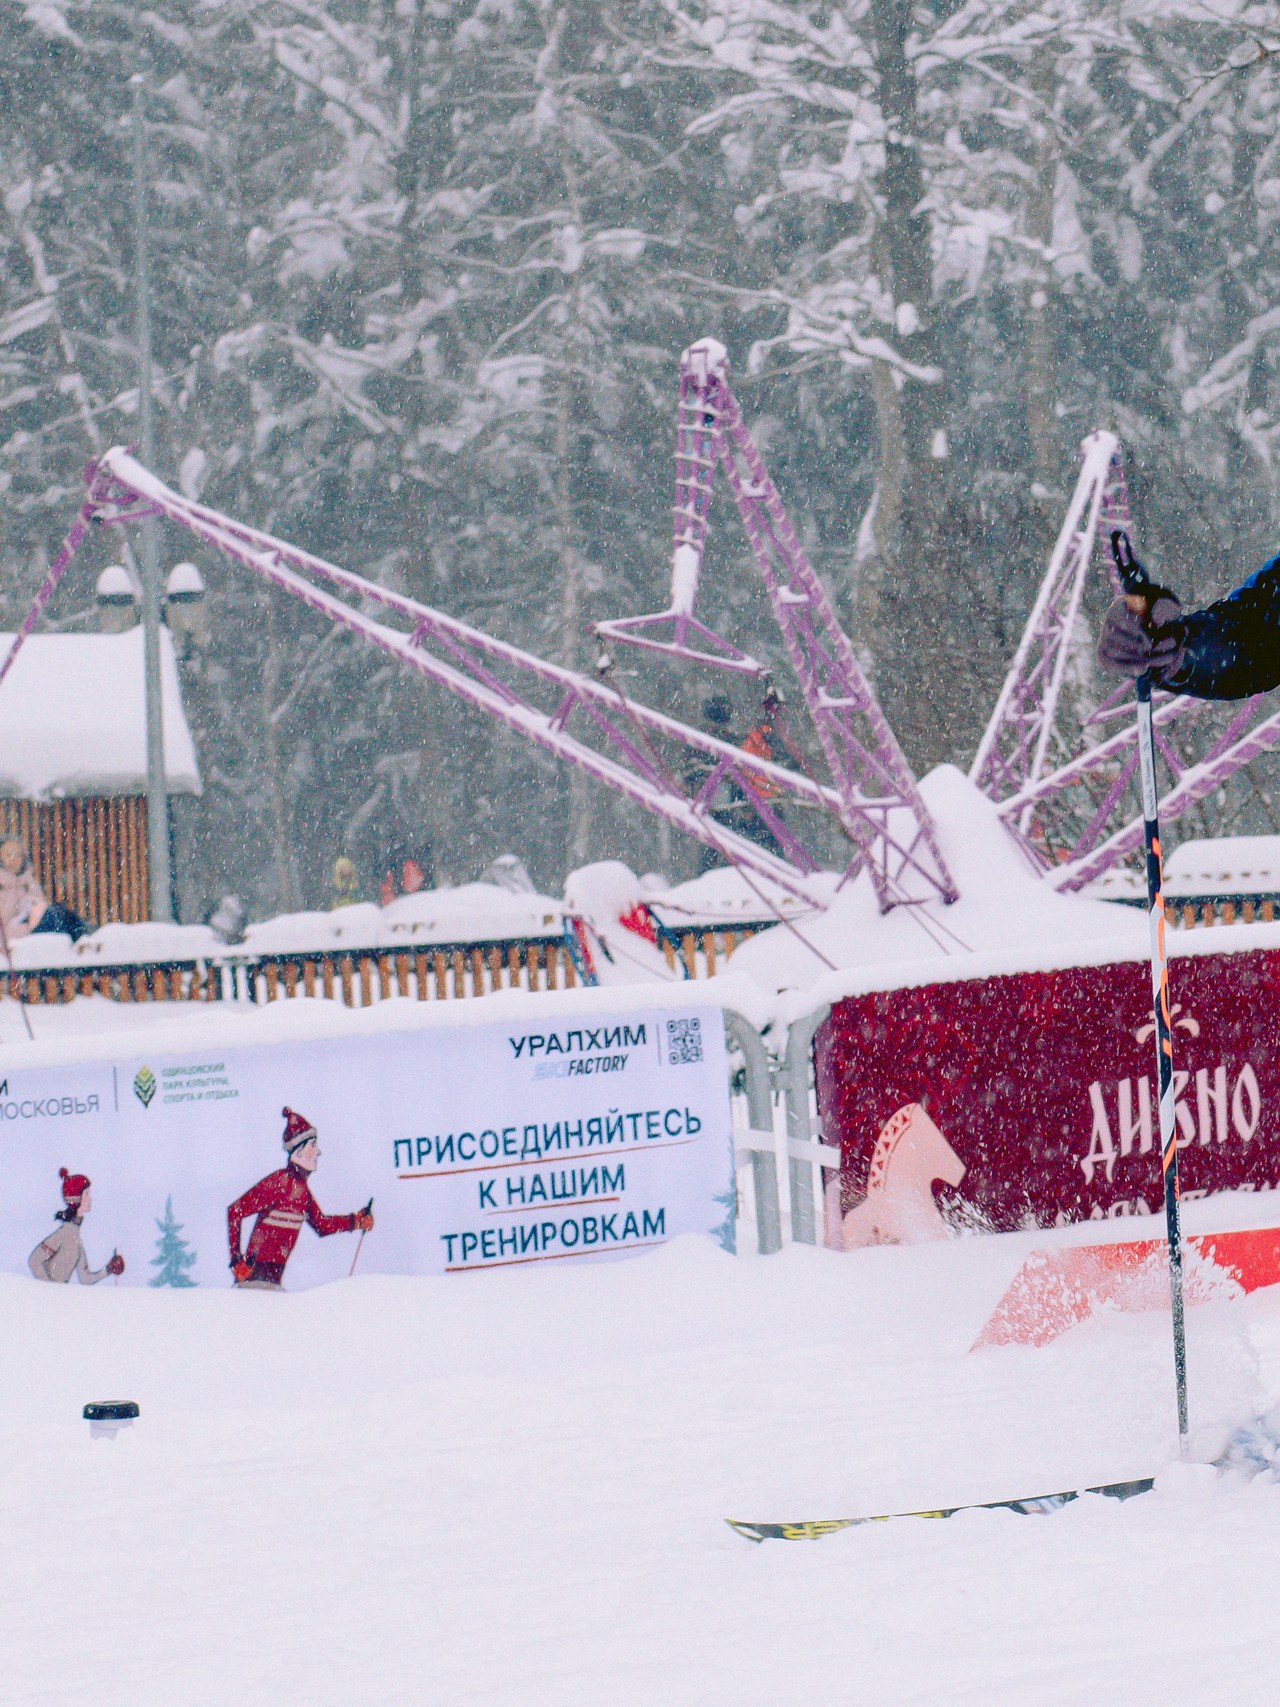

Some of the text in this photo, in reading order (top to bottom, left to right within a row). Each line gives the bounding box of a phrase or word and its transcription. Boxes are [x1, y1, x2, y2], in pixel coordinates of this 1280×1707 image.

[509, 1023, 648, 1059] УРАЛХИМ
[567, 1053, 630, 1077] FACTORY
[0, 1094, 100, 1121] ОСКОВЬЯ
[1080, 1062, 1262, 1186] ДИВНО
[393, 1107, 702, 1169] ПРИСОЕДИНЯЙТЕСЬ
[478, 1163, 626, 1209] К НАШИМ
[440, 1207, 666, 1263] ТРЕНИРОВКАМ
